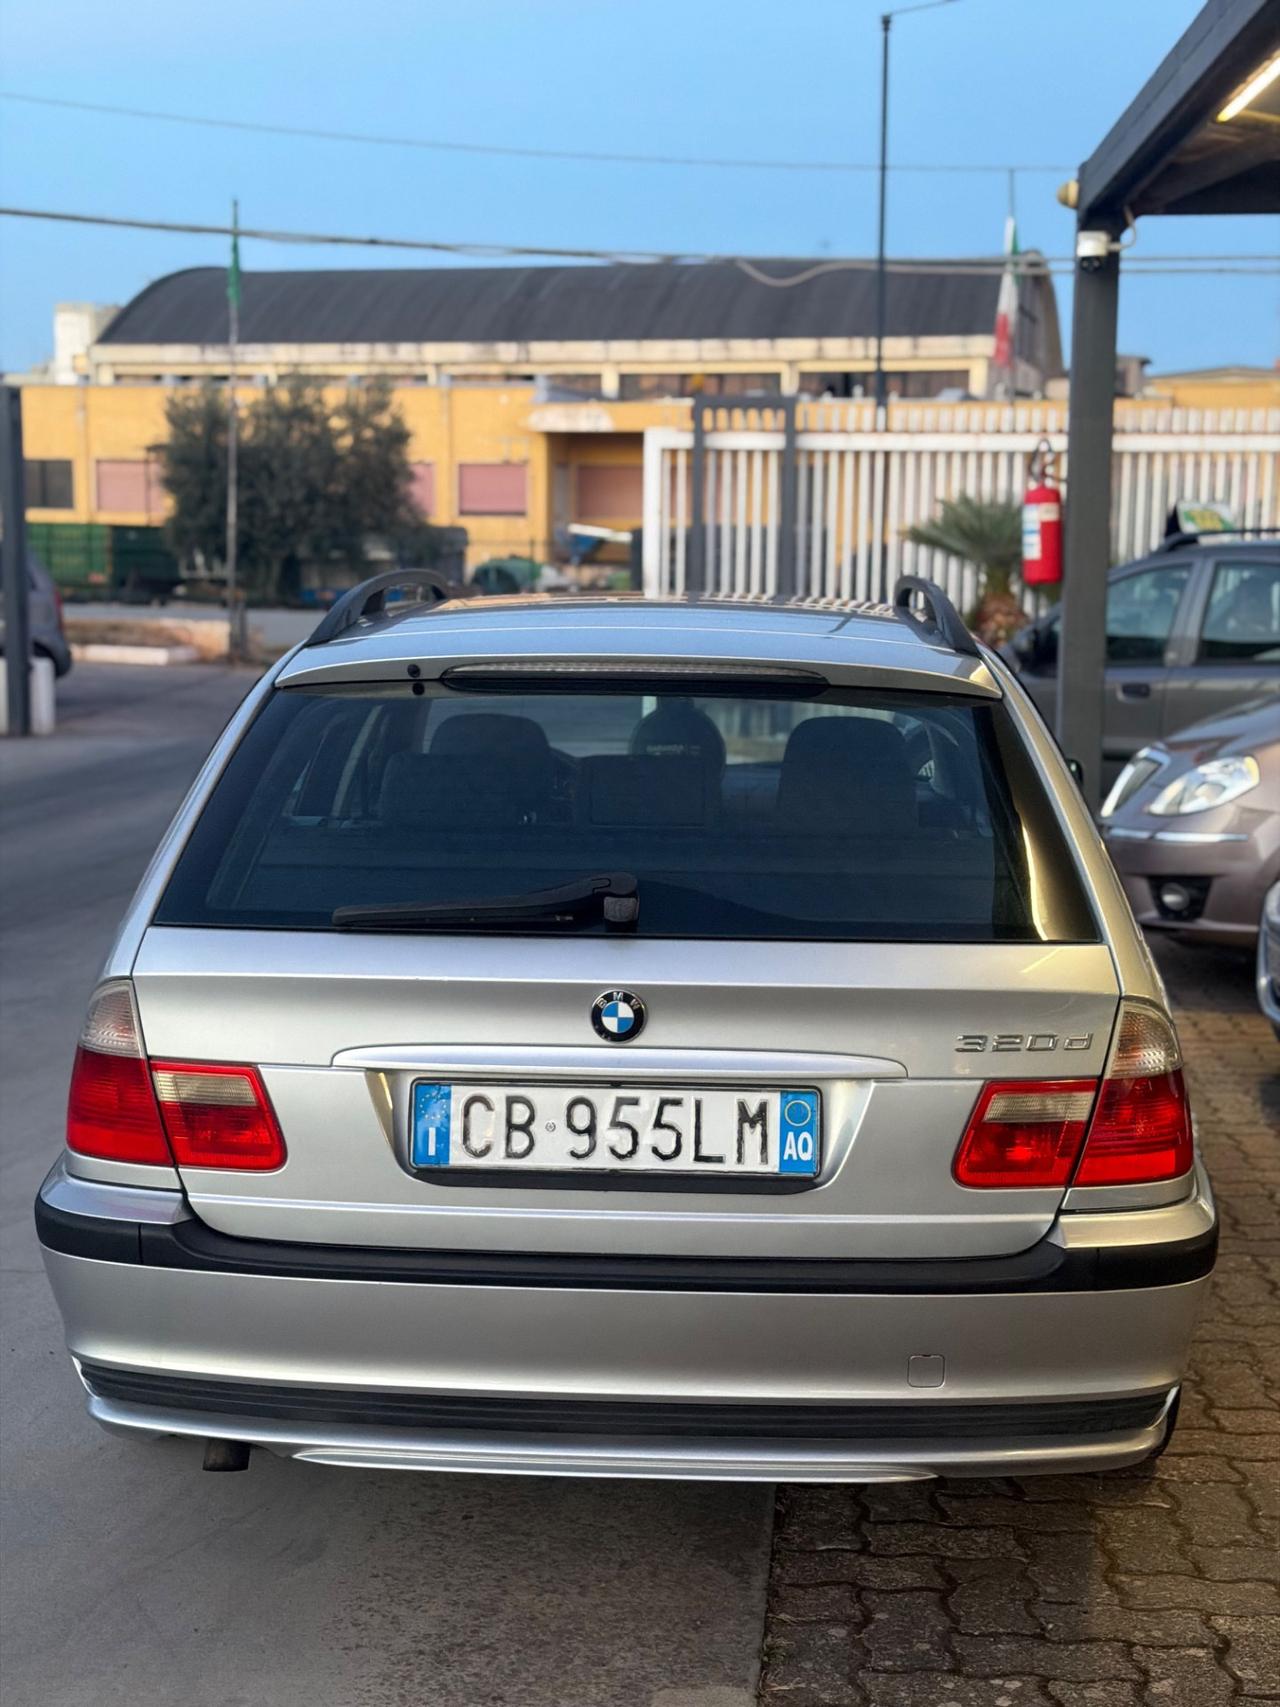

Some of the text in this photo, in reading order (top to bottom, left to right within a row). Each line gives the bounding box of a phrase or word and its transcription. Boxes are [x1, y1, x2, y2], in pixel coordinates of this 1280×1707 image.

[596, 991, 640, 1010] BMW
[955, 1033, 1093, 1052] 320d
[428, 1127, 436, 1156] I
[783, 1131, 813, 1161] AQ
